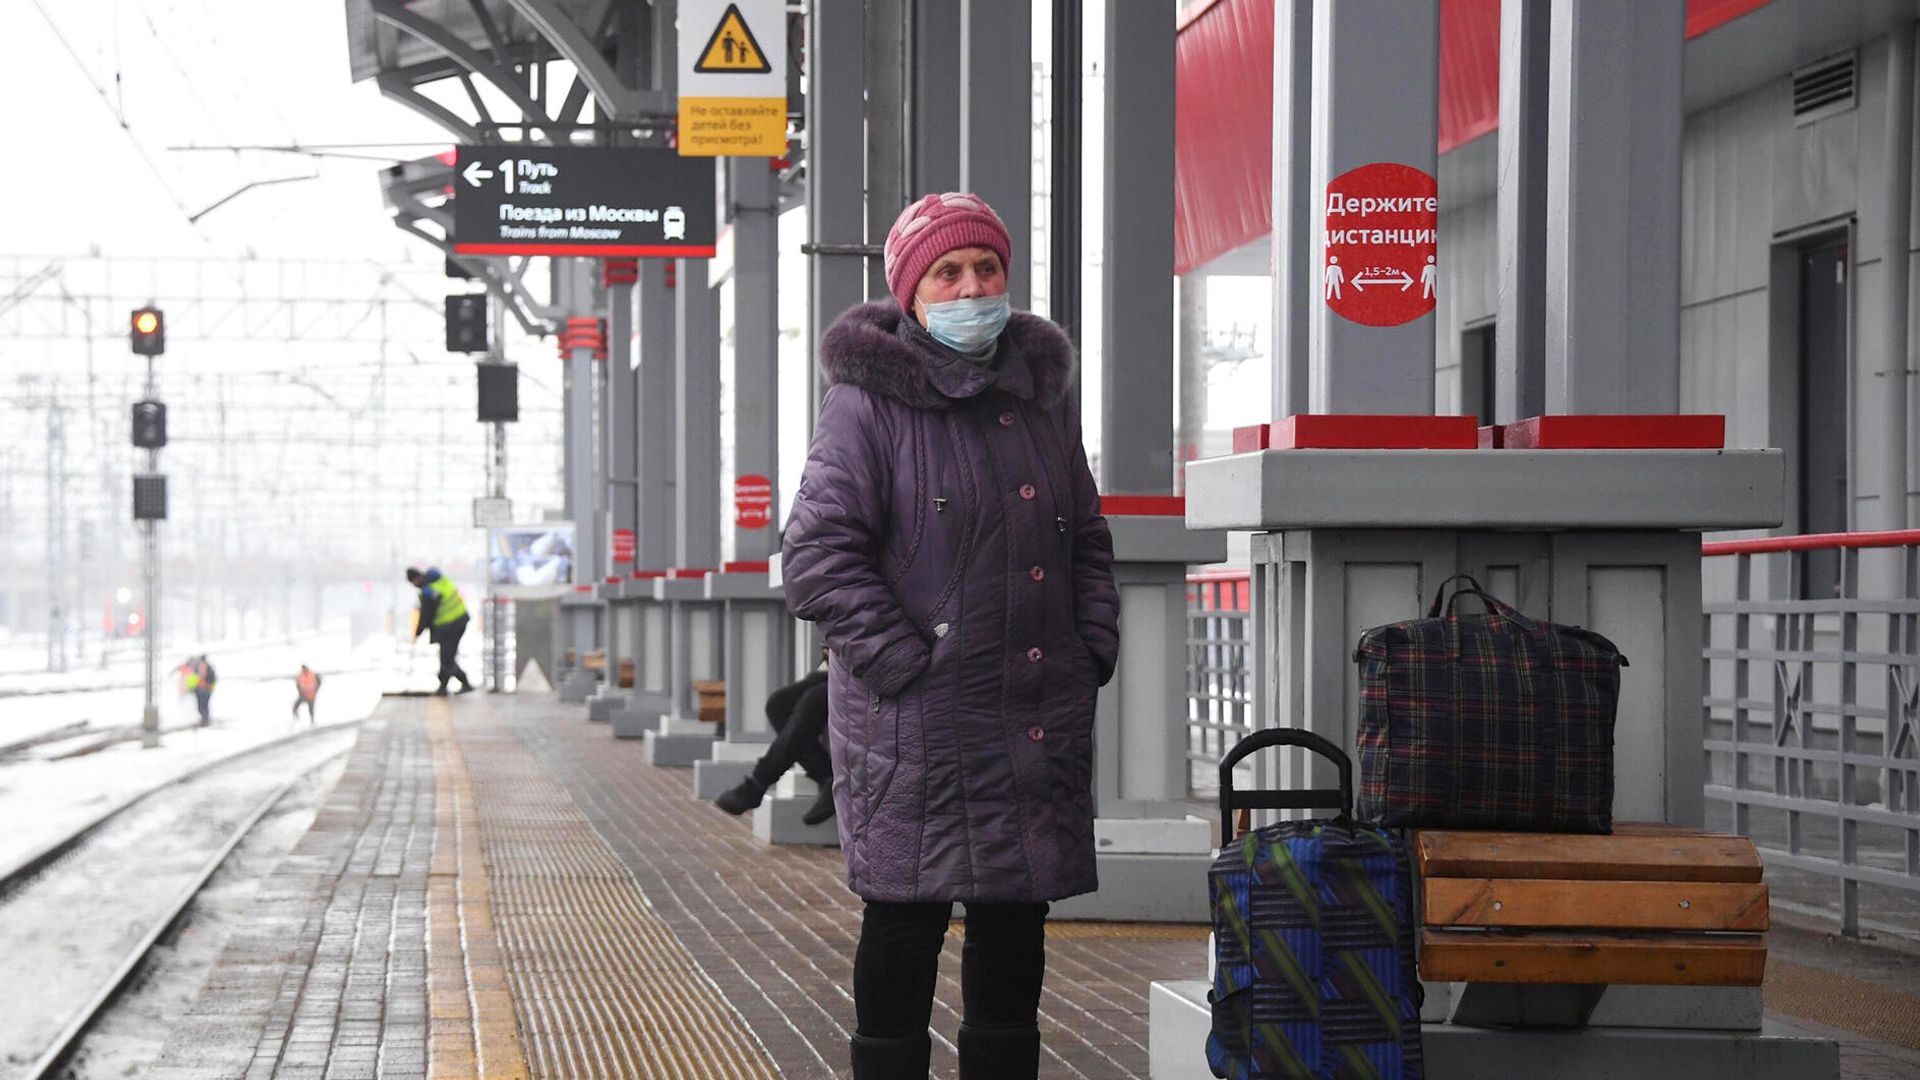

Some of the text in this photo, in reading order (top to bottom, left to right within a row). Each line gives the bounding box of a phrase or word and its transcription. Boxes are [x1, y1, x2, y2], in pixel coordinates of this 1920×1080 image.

[690, 104, 779, 116] Не оставляйте
[691, 119, 752, 131] детей без
[690, 134, 763, 147] присмотра!
[499, 159, 558, 194] 1 Путь
[519, 181, 552, 194] Track
[1327, 193, 1437, 217] Держите
[500, 204, 659, 223] Поезда из Москвы
[500, 225, 622, 239] Trains from Moscow
